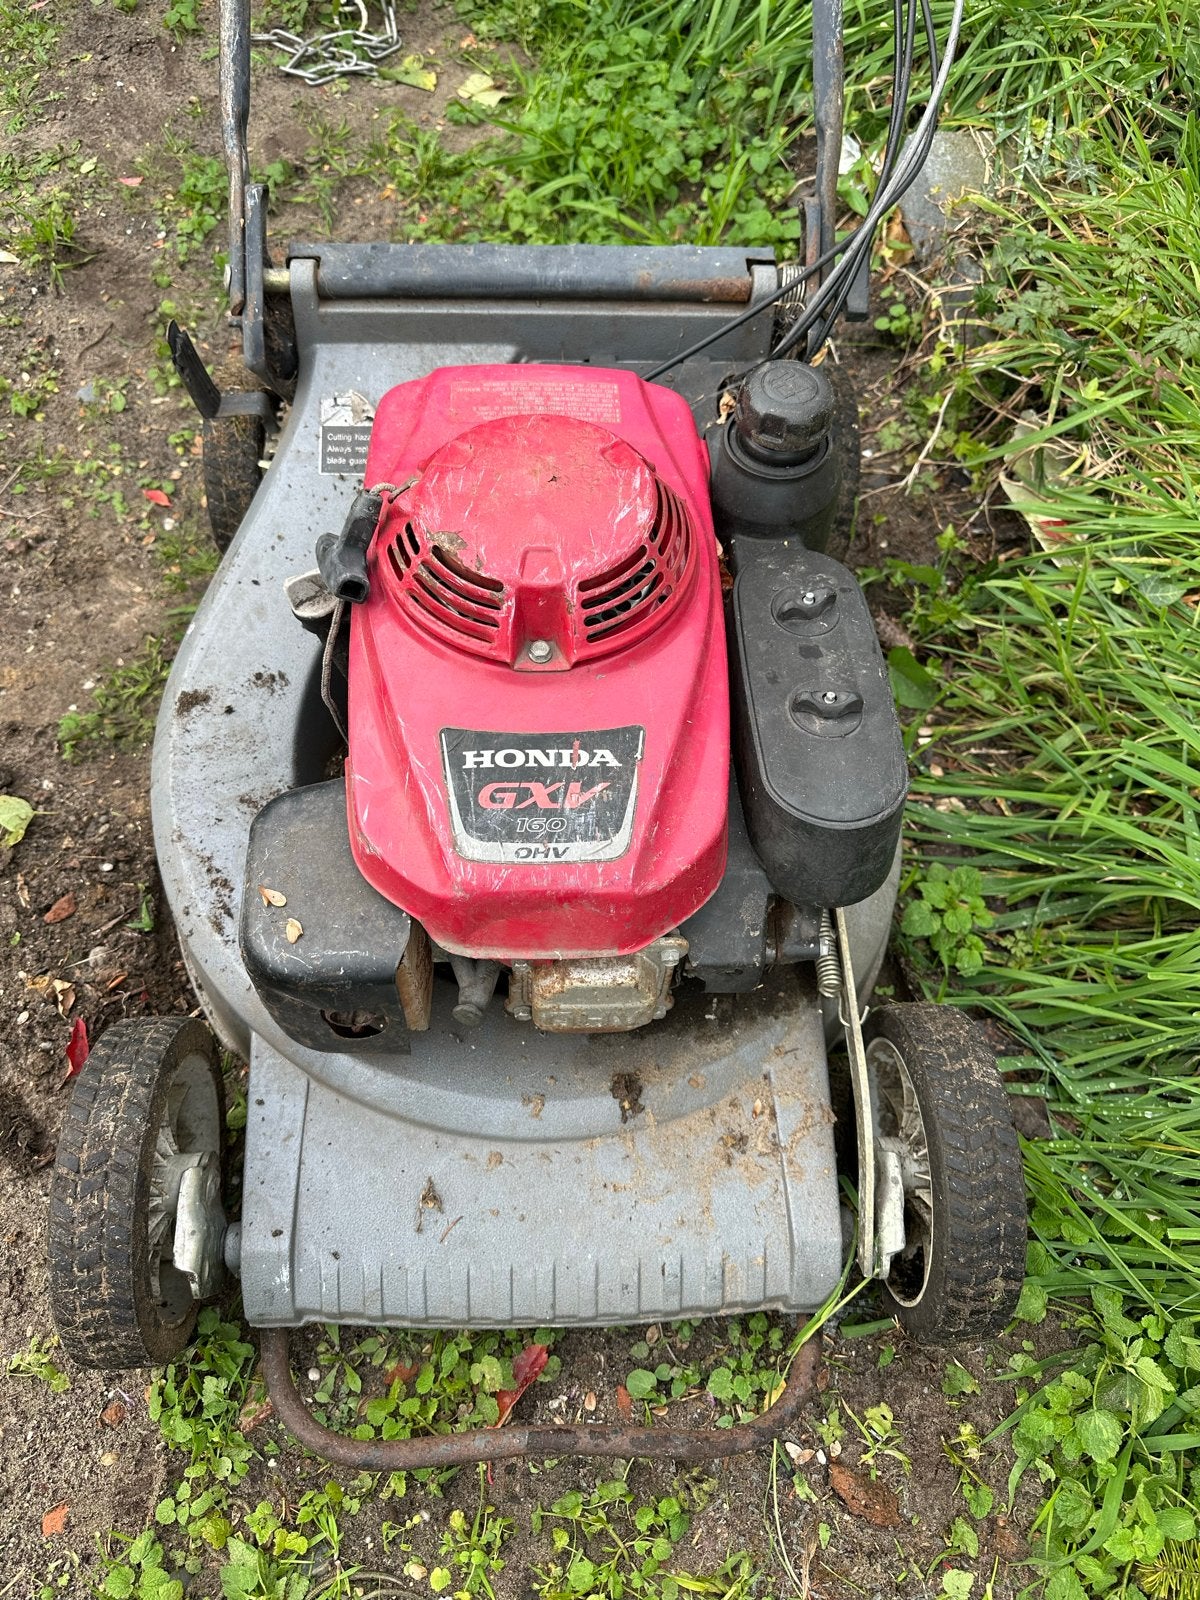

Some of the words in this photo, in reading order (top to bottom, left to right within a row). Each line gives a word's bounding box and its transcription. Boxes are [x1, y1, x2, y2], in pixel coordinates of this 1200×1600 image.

[327, 433, 352, 442] Cutting
[326, 445, 352, 454] Always
[462, 749, 622, 769] HONDA
[478, 781, 612, 809] GXV
[516, 817, 567, 832] 160
[514, 847, 571, 859] OHV
